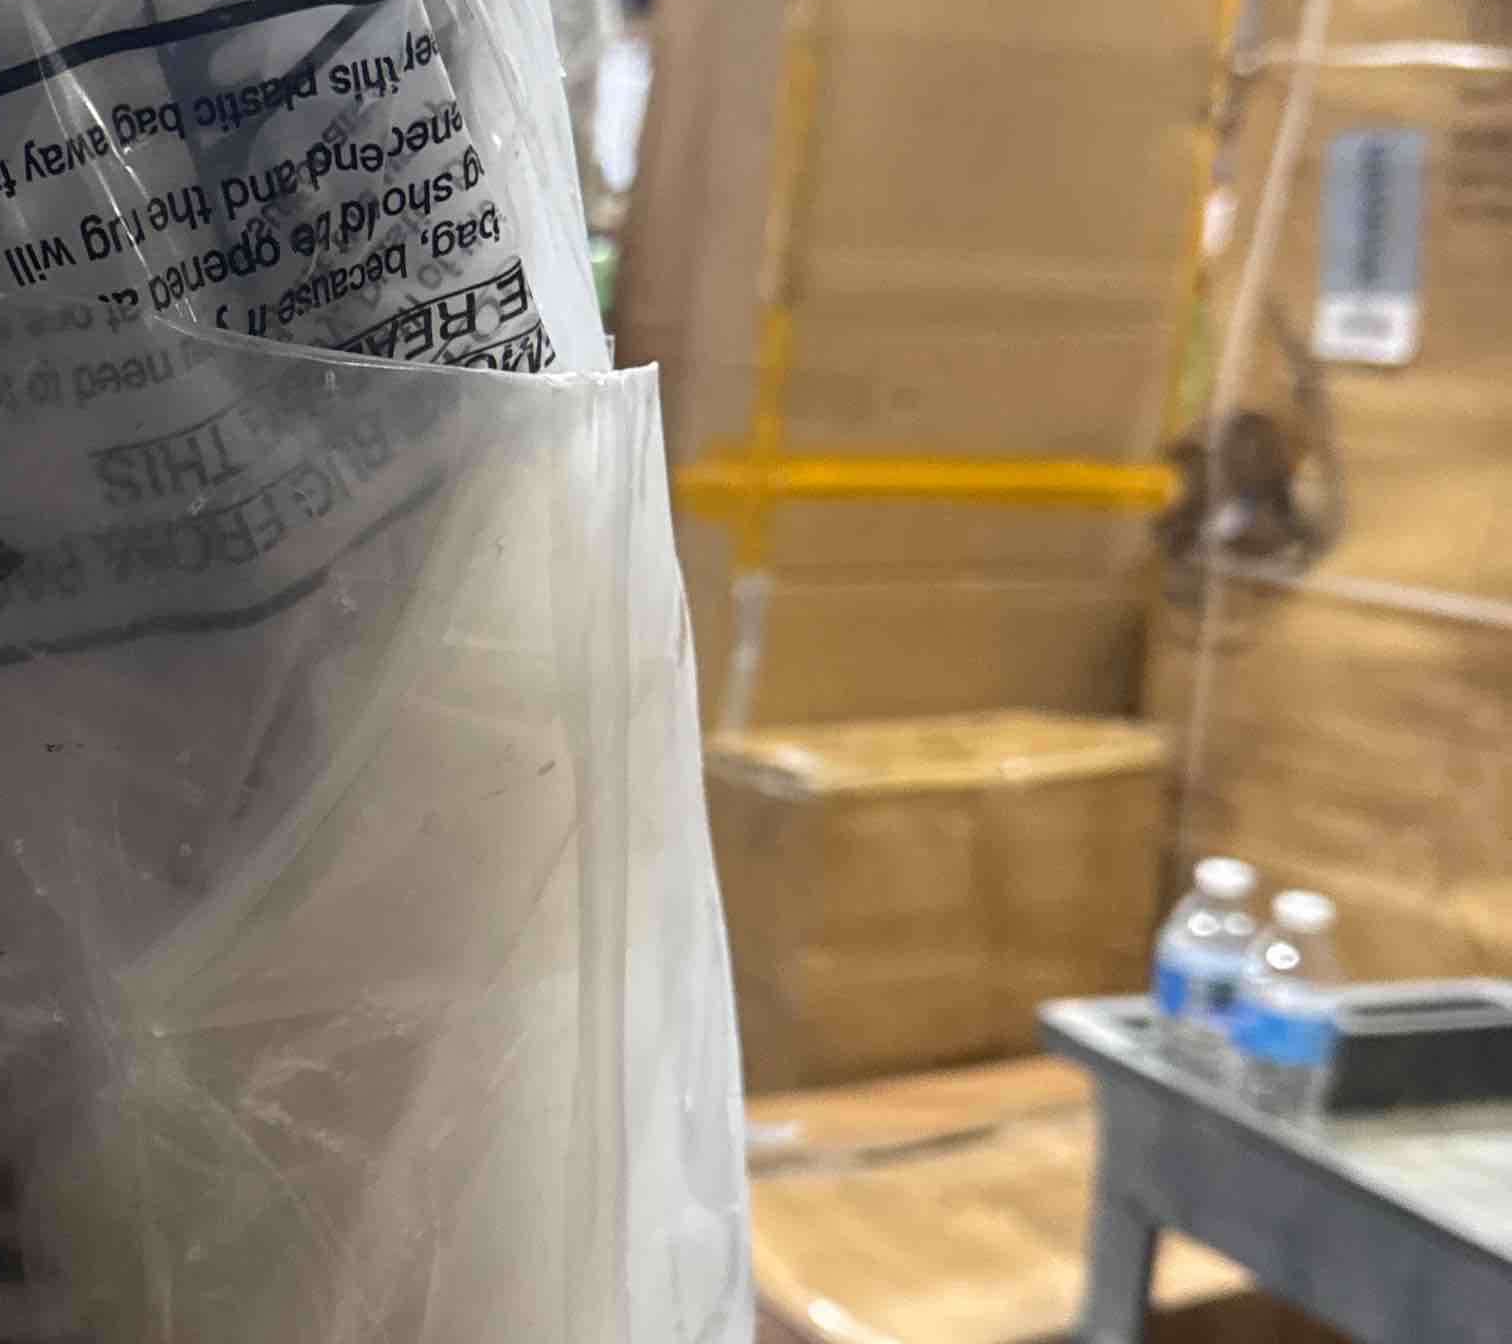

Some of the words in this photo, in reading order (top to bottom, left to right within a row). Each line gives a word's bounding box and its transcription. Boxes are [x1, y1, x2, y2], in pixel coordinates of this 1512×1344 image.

[112, 103, 186, 141] bag
[192, 72, 318, 132] plastic
[24, 128, 110, 183] away
[148, 184, 212, 232] the
[224, 156, 302, 220] and
[5, 234, 76, 286] will
[80, 214, 144, 262] rug
[148, 229, 281, 313] opened
[277, 243, 408, 326] because
